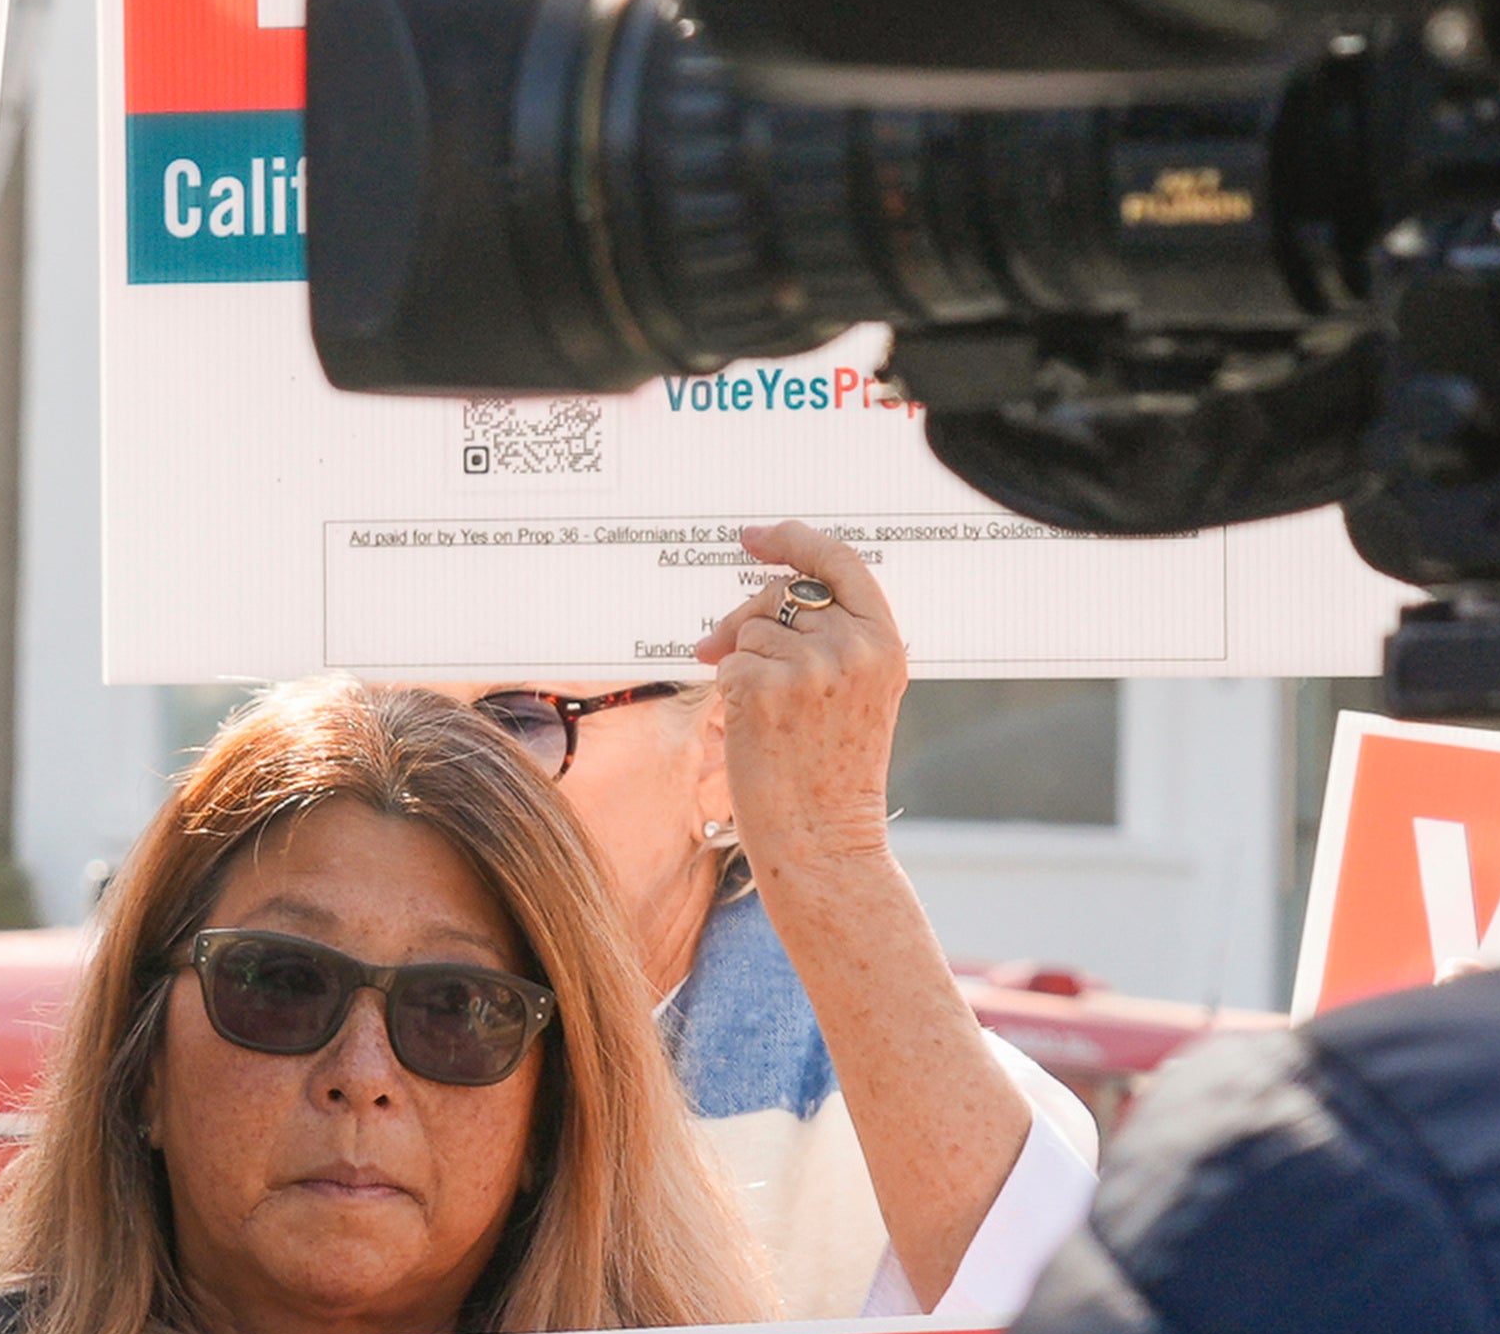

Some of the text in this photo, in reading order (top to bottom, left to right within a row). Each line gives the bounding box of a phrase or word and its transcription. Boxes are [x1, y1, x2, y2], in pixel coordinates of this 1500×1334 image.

[349, 529, 371, 546] Ad
[375, 529, 408, 547] paid
[412, 528, 433, 545] for
[437, 529, 456, 547] by
[460, 528, 489, 544] Yes
[492, 531, 513, 544] on
[517, 527, 555, 546] Prop
[559, 527, 579, 544] 36
[593, 525, 687, 543] Californians
[690, 525, 711, 542] for
[716, 525, 745, 542] Saf
[875, 522, 958, 541] sponsored
[963, 522, 981, 541] by
[986, 521, 1044, 539] Golden
[658, 549, 679, 565] Ad
